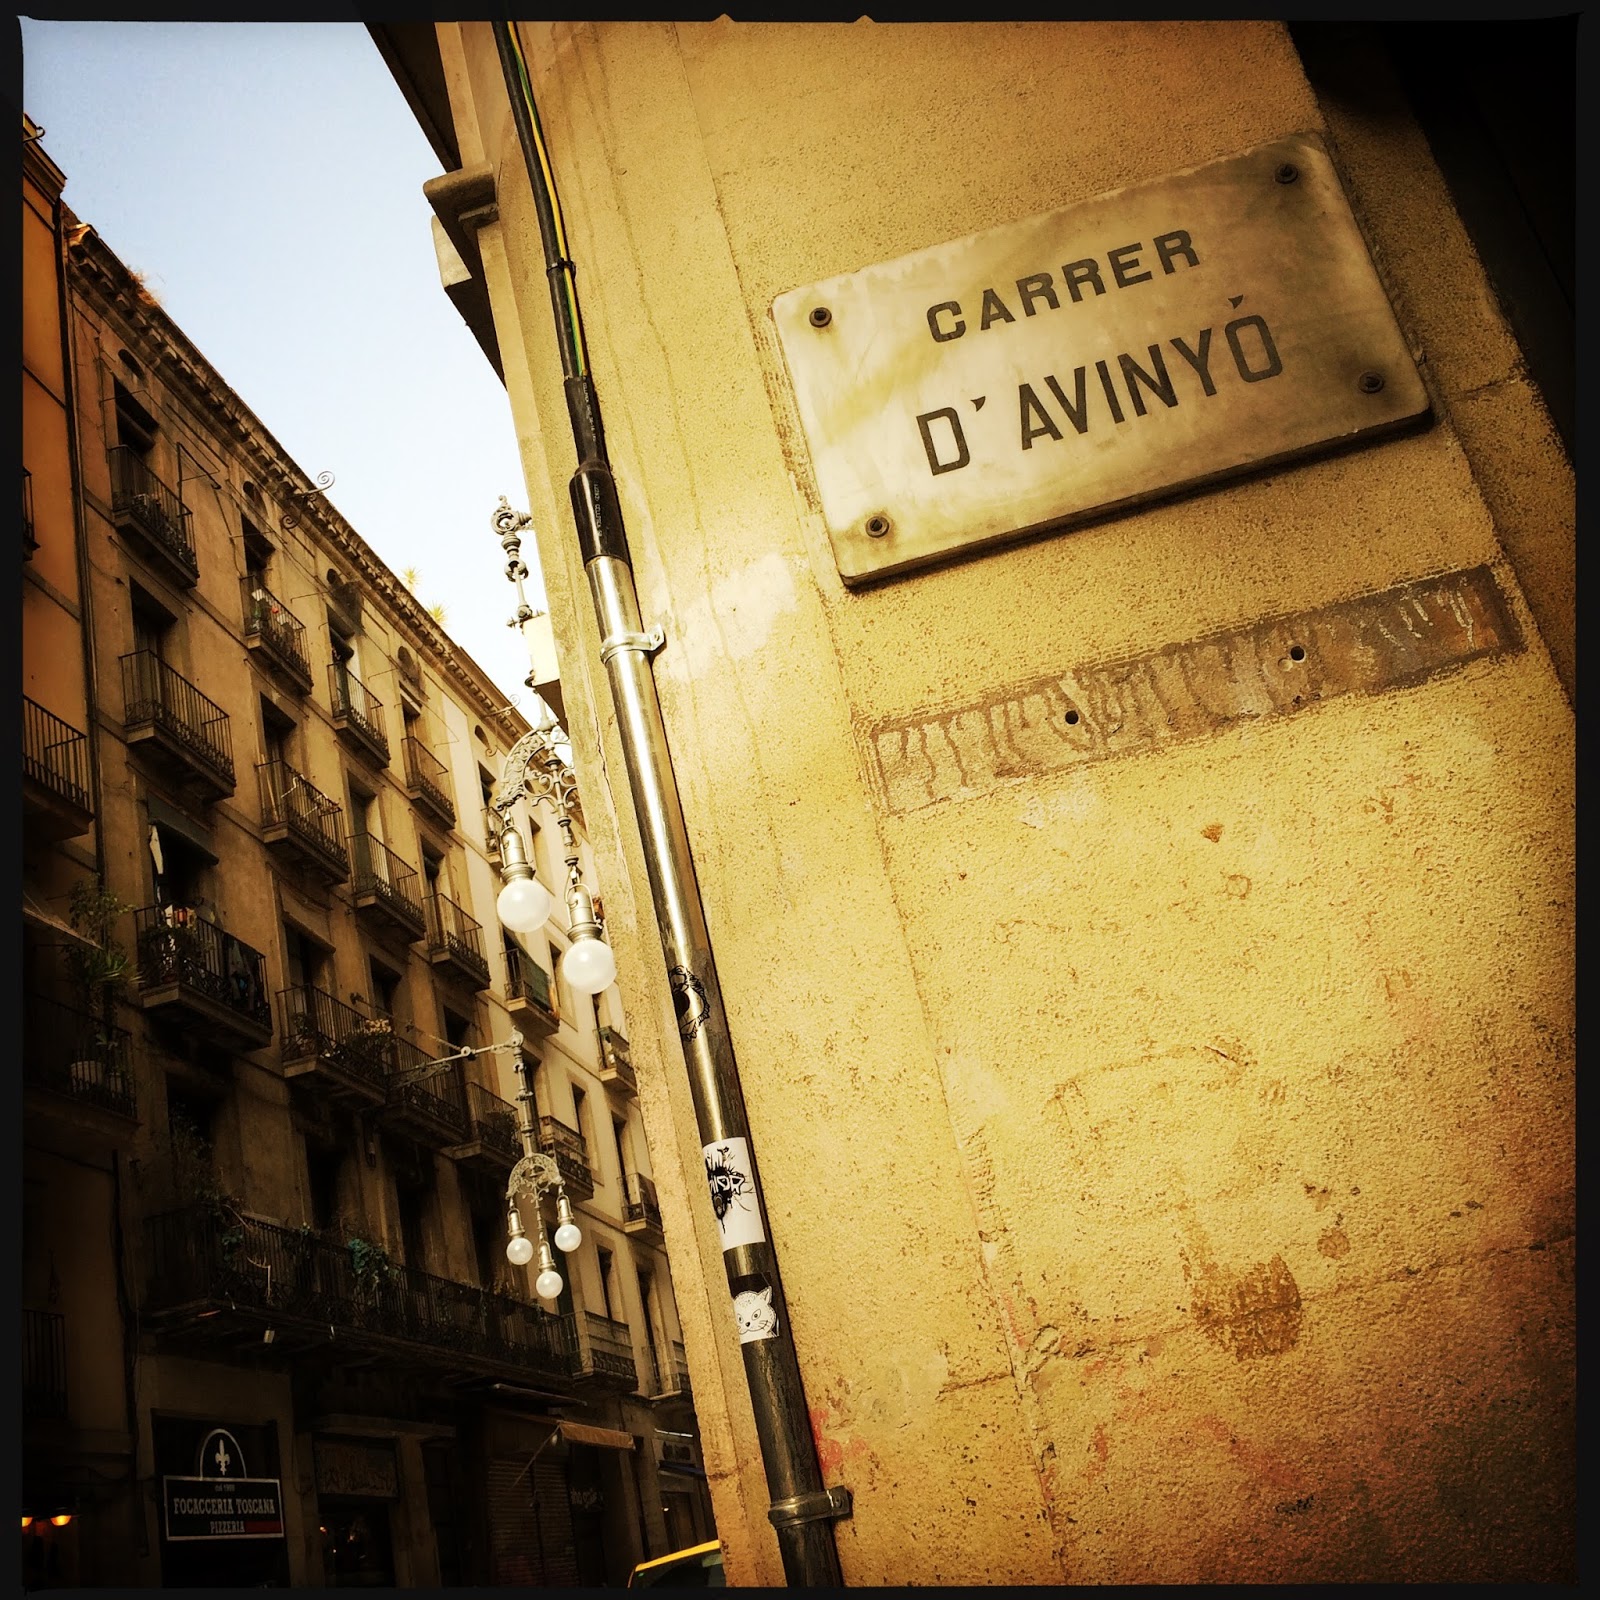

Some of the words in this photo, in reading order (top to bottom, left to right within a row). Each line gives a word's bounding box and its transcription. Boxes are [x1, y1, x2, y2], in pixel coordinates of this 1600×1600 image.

[926, 229, 1200, 343] CARRER
[173, 1497, 234, 1515] FOCACCERIA
[235, 1498, 276, 1514] TOSCANA
[209, 1520, 246, 1534] PIZZERIA
